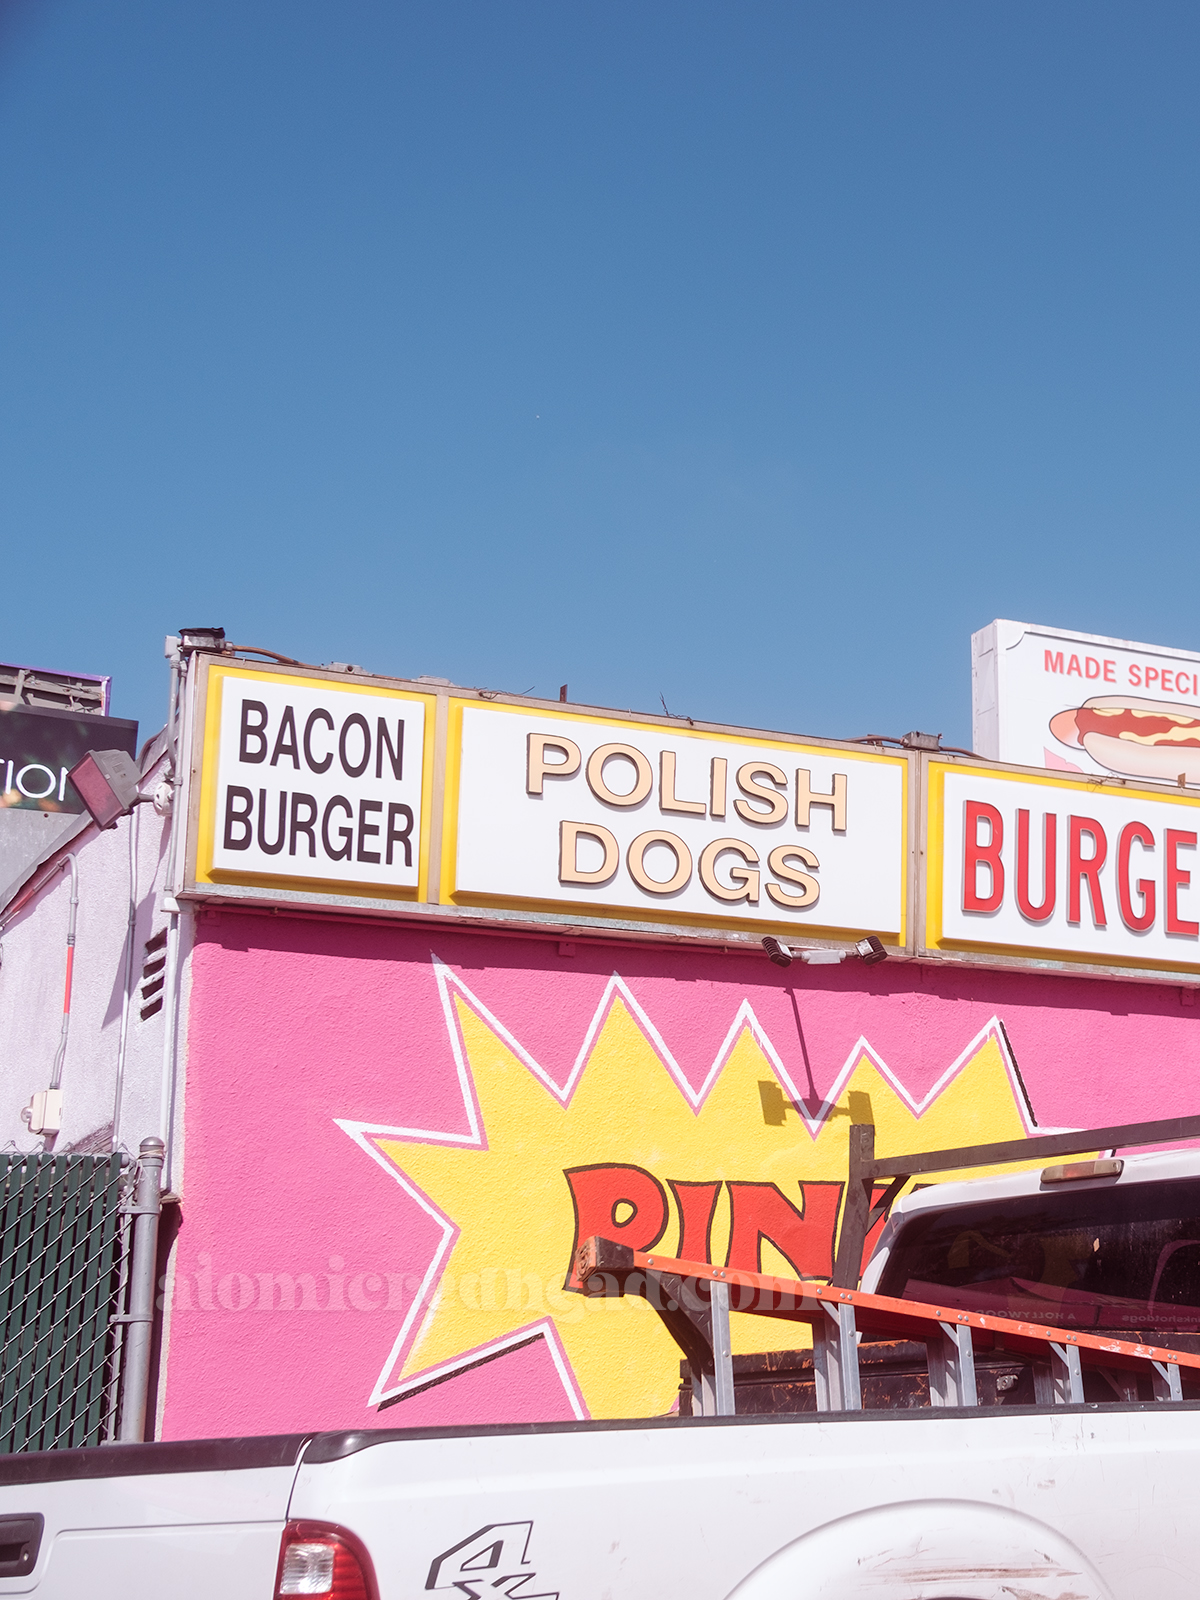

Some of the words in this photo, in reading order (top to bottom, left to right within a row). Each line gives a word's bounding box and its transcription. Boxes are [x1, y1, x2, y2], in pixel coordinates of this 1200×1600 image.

[1043, 649, 1117, 685] MADE
[0, 757, 69, 802] IO
[239, 698, 405, 781] BACON
[526, 732, 848, 832] POLISH
[223, 784, 414, 867] BURGER
[558, 819, 821, 908] DOGS
